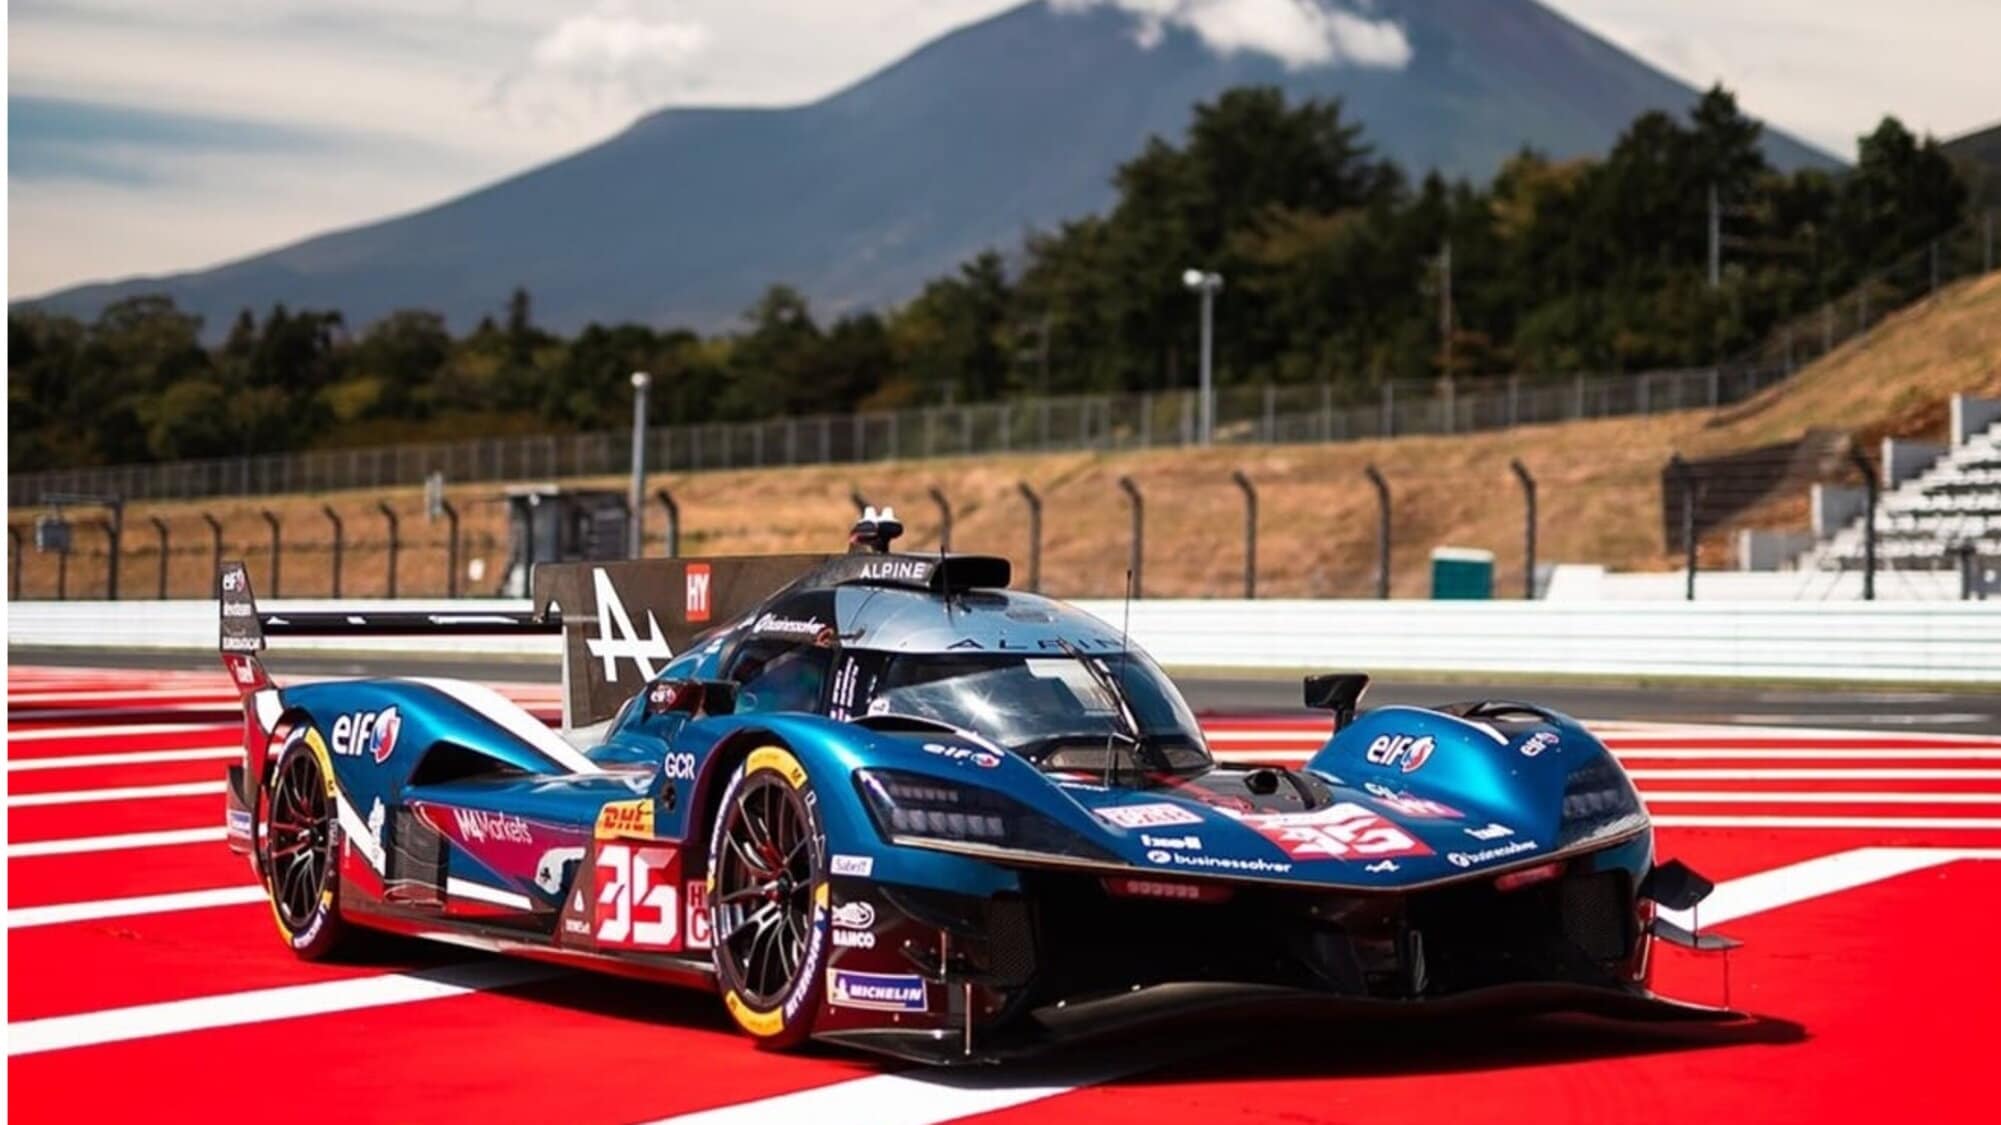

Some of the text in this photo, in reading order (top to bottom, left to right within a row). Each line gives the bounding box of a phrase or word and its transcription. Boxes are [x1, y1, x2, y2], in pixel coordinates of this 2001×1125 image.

[860, 562, 925, 580] ALPINE
[686, 573, 711, 612] HY
[332, 713, 375, 756] elf
[923, 743, 972, 759] elf
[1366, 735, 1412, 765] elf
[665, 752, 695, 779] GCR
[1174, 853, 1293, 873] businessolver
[596, 844, 677, 946] 35
[850, 984, 922, 1001] MICHELIN
